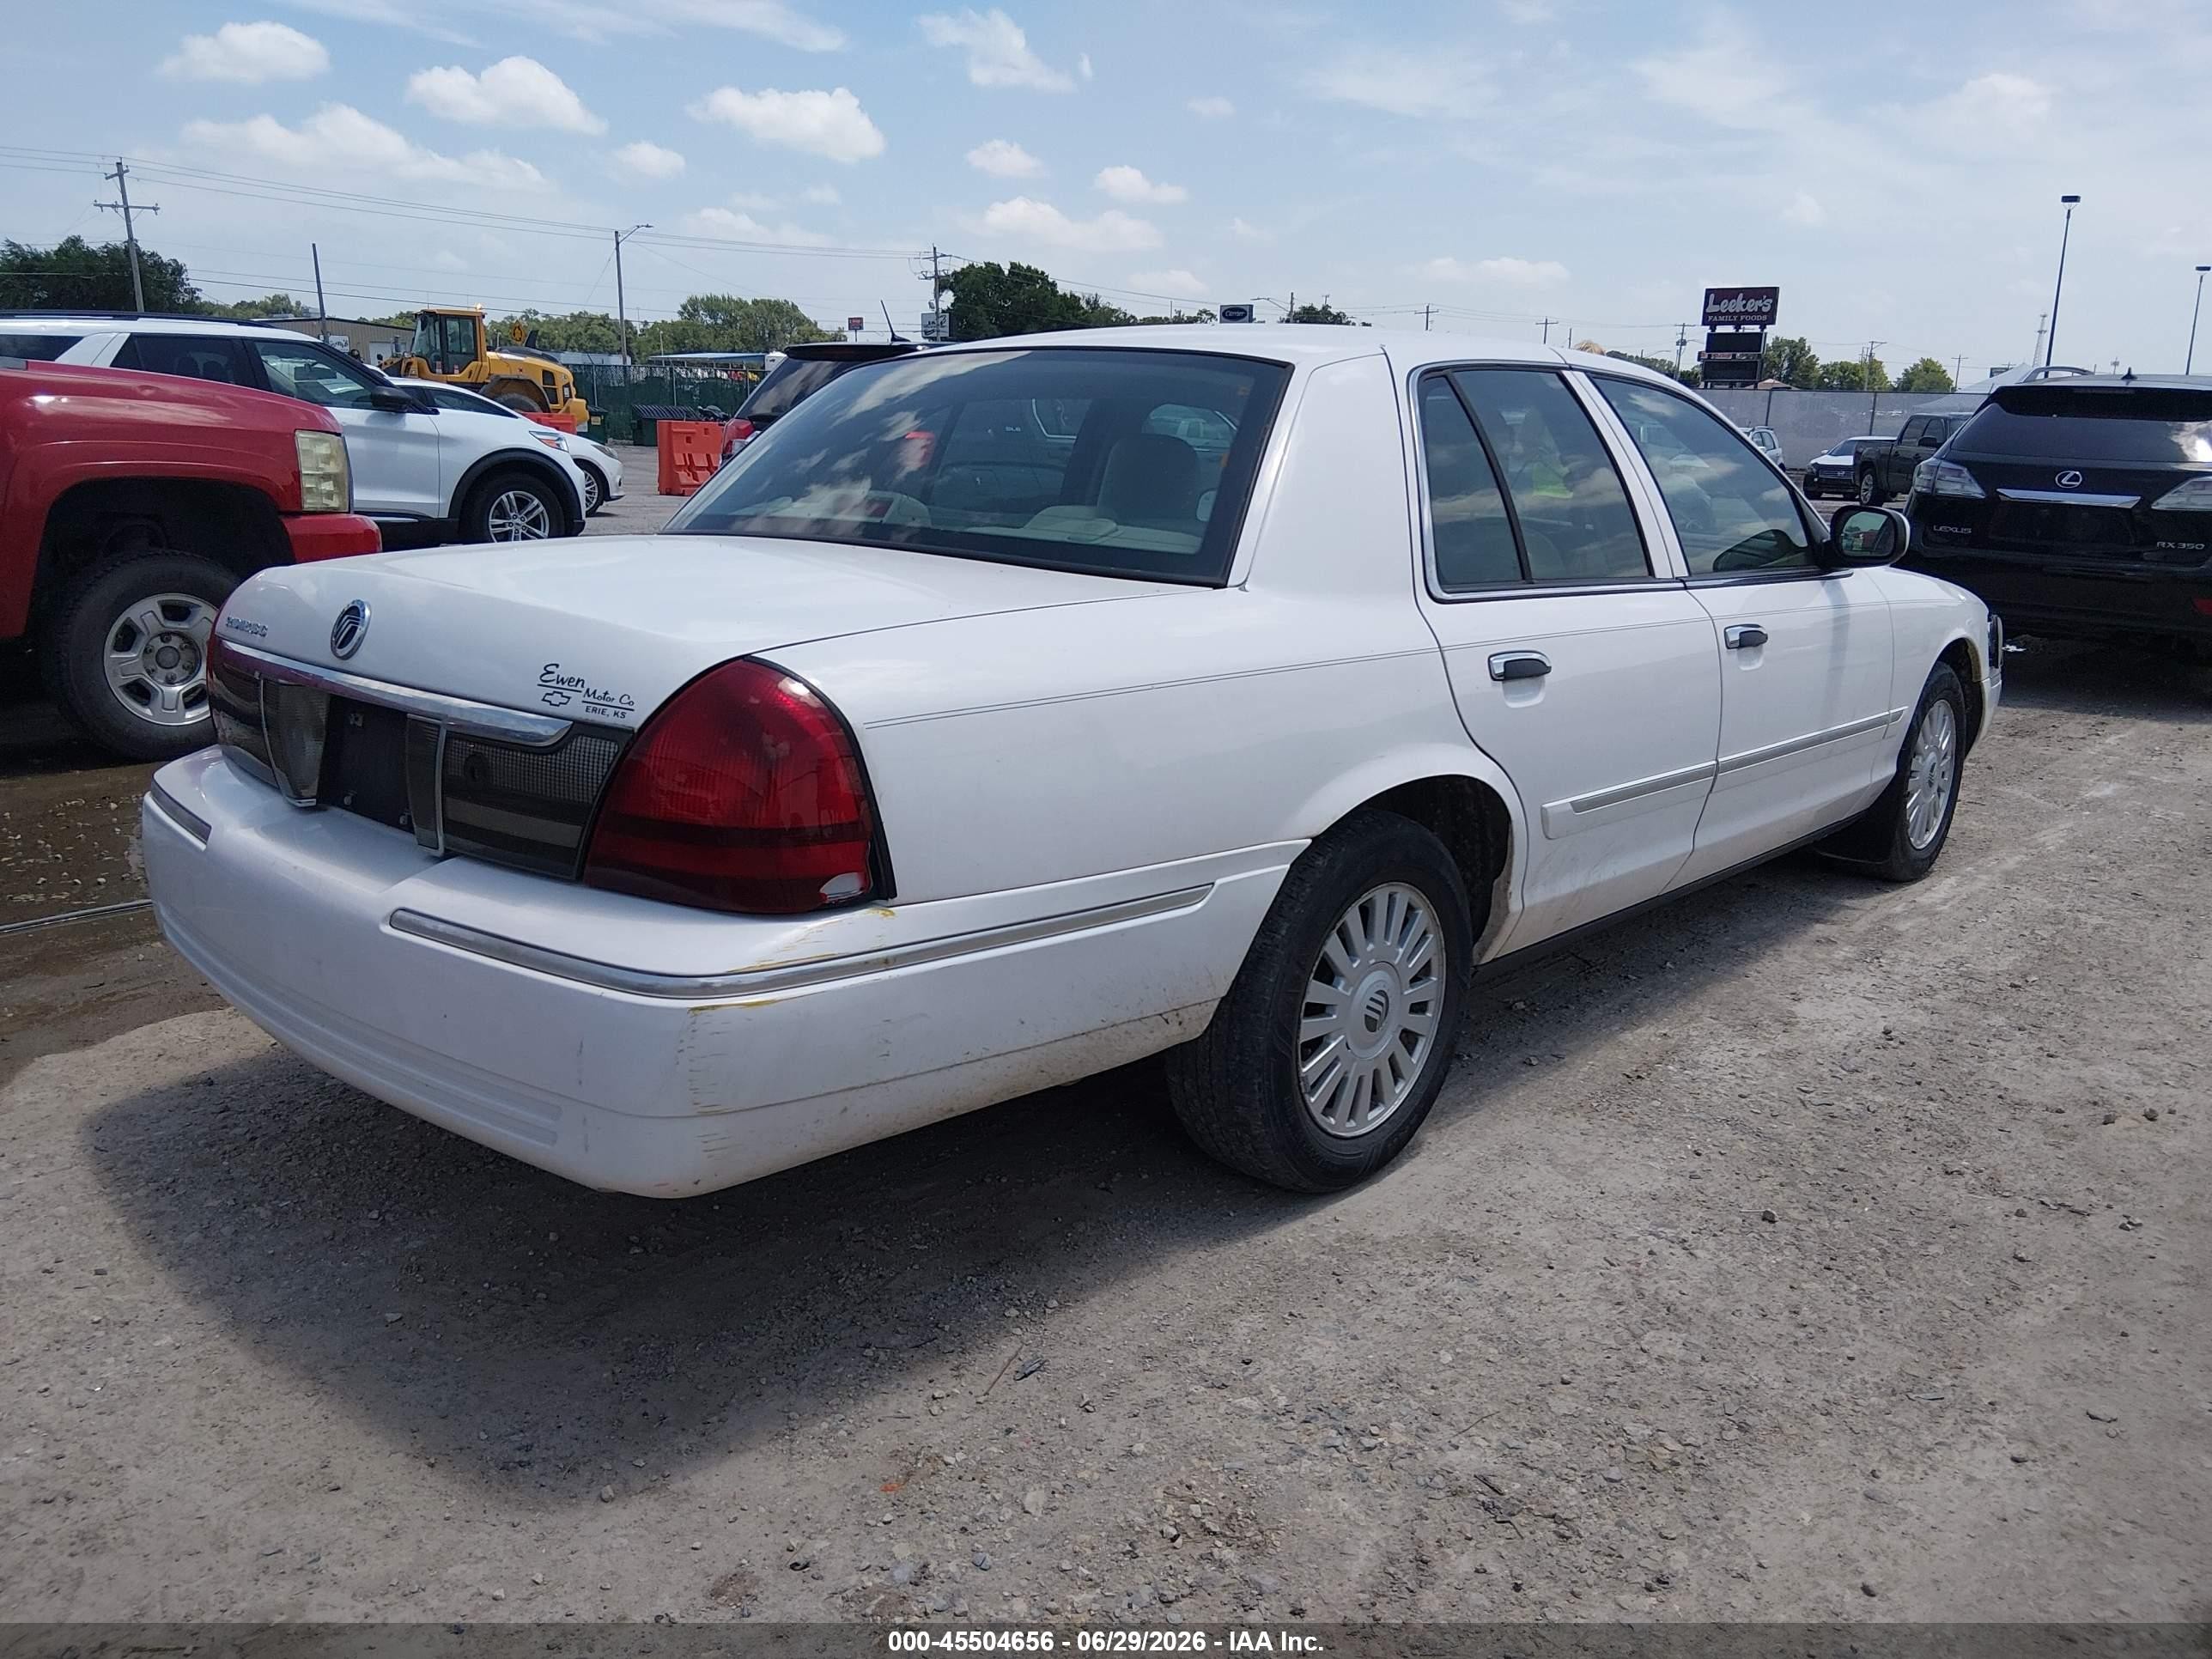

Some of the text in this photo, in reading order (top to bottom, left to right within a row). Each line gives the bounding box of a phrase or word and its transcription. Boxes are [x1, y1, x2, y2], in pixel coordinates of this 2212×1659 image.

[1705, 293, 1773, 313] Leeker's
[1933, 525, 1972, 534] LEXUS
[2156, 541, 2206, 550] RX 350
[539, 663, 585, 688] Ewen
[583, 688, 635, 707] Motor Co
[585, 705, 627, 719] ERIE, KS
